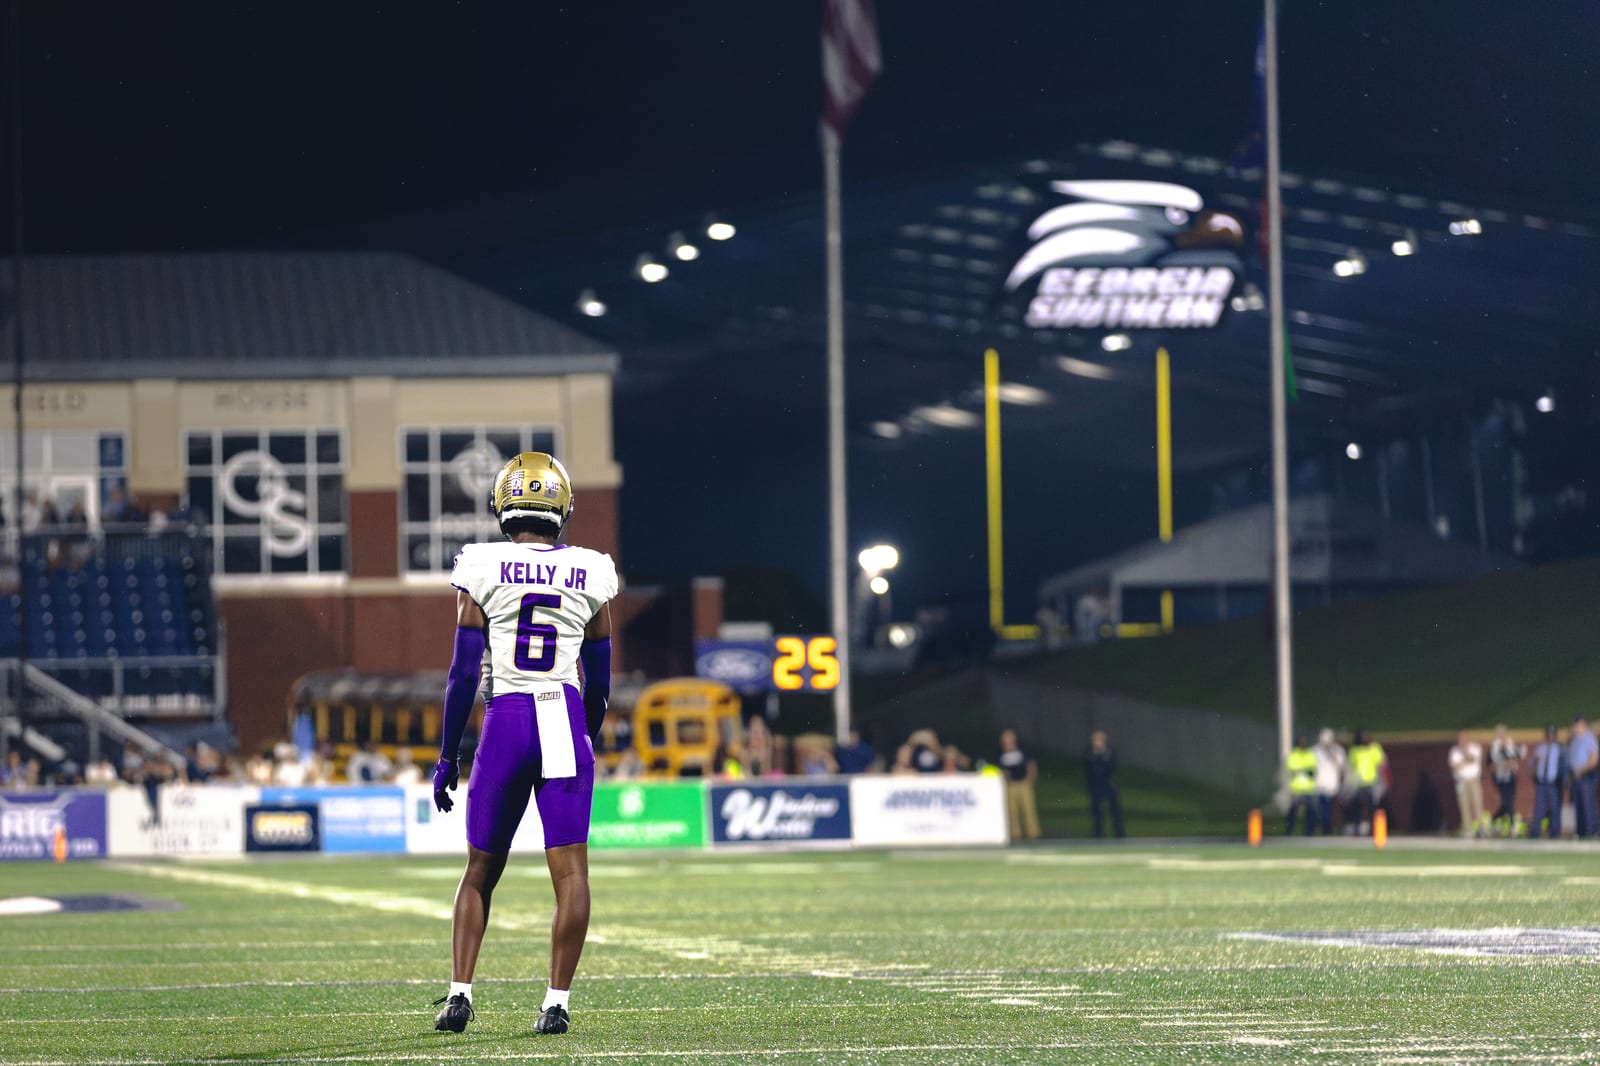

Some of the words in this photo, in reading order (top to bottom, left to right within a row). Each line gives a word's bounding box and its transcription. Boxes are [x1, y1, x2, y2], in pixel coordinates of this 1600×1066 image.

[1037, 267, 1234, 297] GEORGIA
[1024, 296, 1223, 328] SOUTHERN
[500, 562, 557, 585] KELLY
[564, 567, 587, 591] JR
[512, 592, 564, 673] 6
[773, 636, 840, 690] 25
[537, 691, 560, 701] JMU
